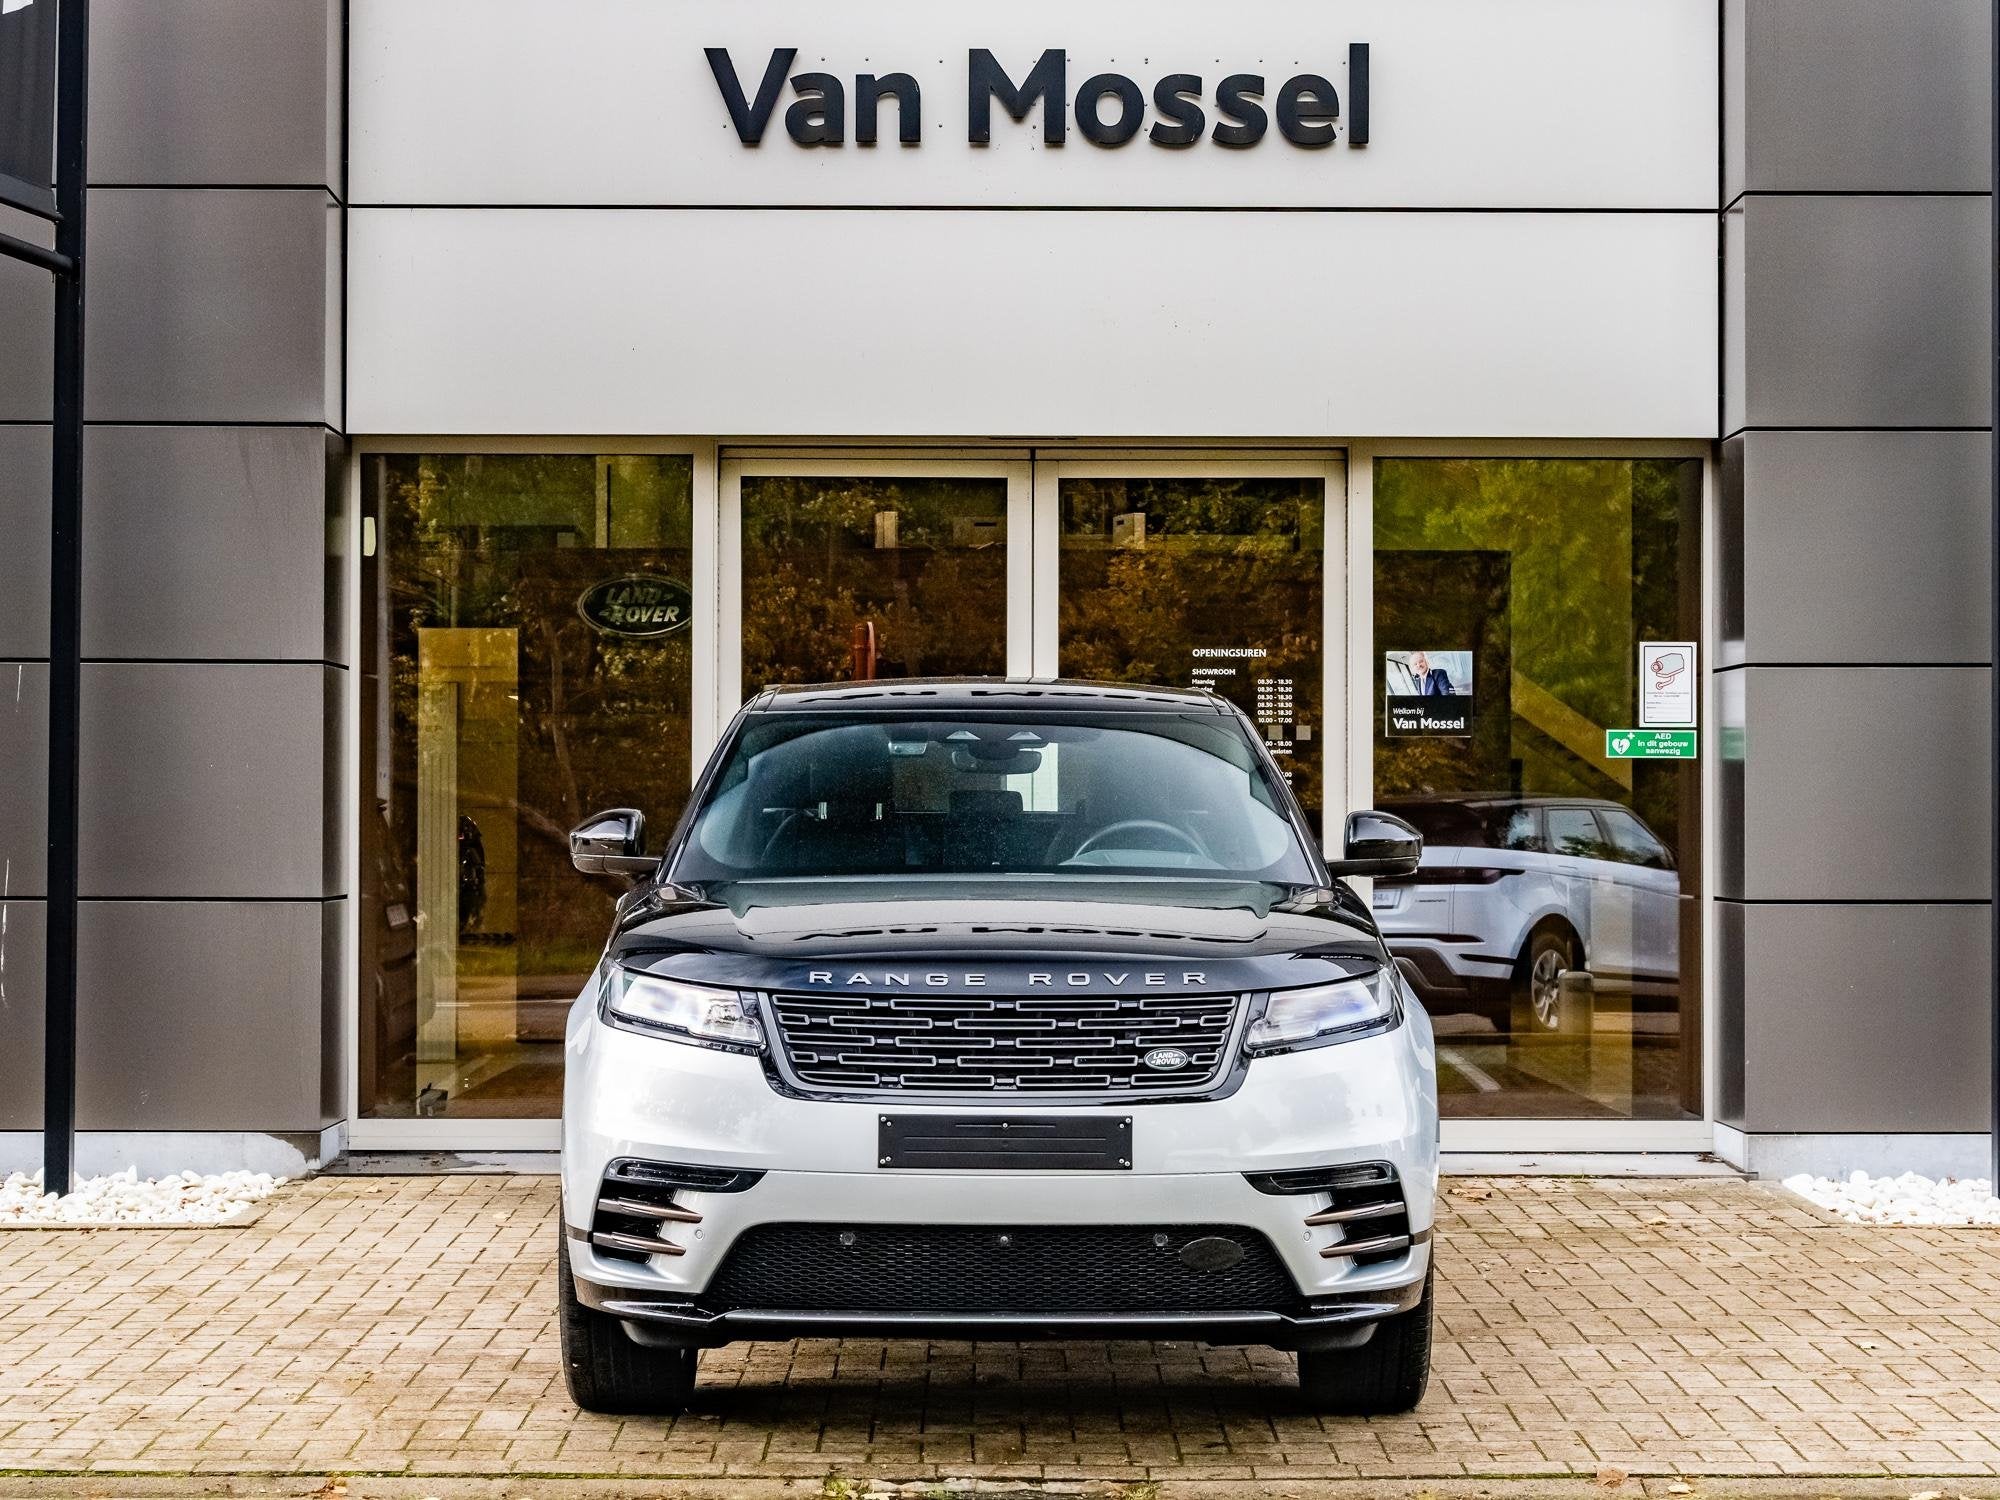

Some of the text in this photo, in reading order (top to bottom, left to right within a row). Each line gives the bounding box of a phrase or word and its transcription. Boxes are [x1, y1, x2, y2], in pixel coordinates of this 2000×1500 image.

[703, 42, 1370, 146] Van Mossel
[606, 586, 662, 604] LAND
[608, 605, 680, 622] ROVER
[1192, 648, 1267, 657] OPENINGSUREN
[1416, 708, 1425, 716] bij
[1393, 717, 1465, 729] Van Mossel
[1659, 740, 1689, 748] gebouw
[1646, 747, 1681, 755] aanwezig
[809, 971, 1206, 987] RANGE ROVER
